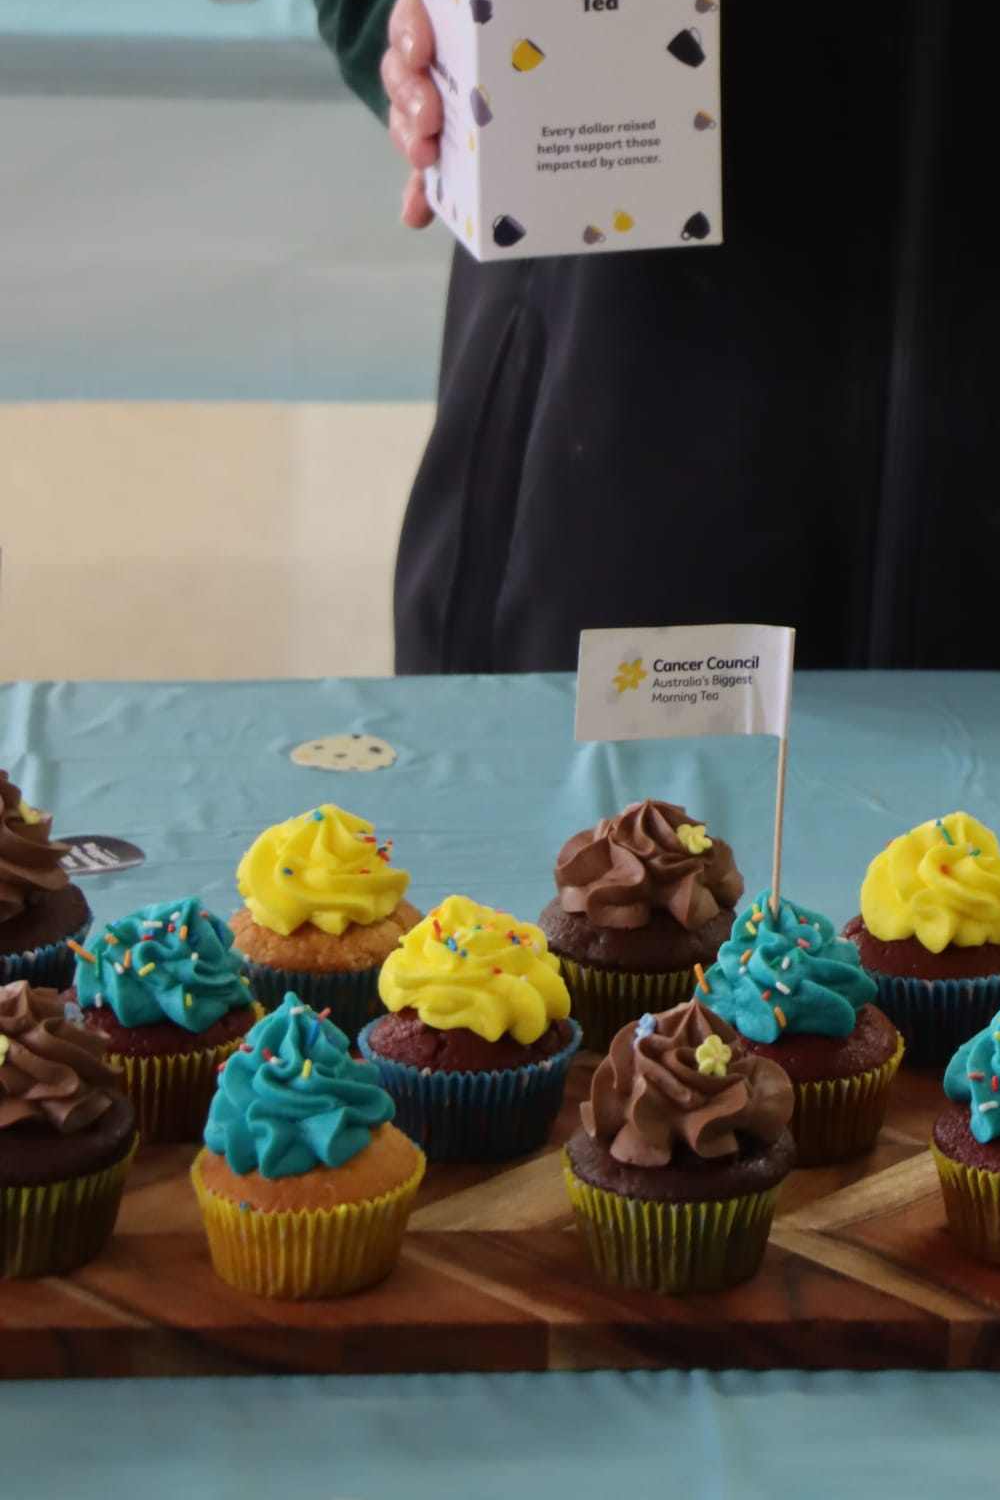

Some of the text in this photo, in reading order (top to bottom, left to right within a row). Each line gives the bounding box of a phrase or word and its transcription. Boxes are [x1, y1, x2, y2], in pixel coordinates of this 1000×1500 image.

[542, 119, 656, 138] Every dollar raised
[537, 136, 661, 155] helps support those
[537, 153, 662, 172] impacted by cancer.
[653, 656, 760, 673] Cancer Council
[652, 674, 753, 688] Australia's Biggest
[652, 690, 719, 704] Morning Tea
